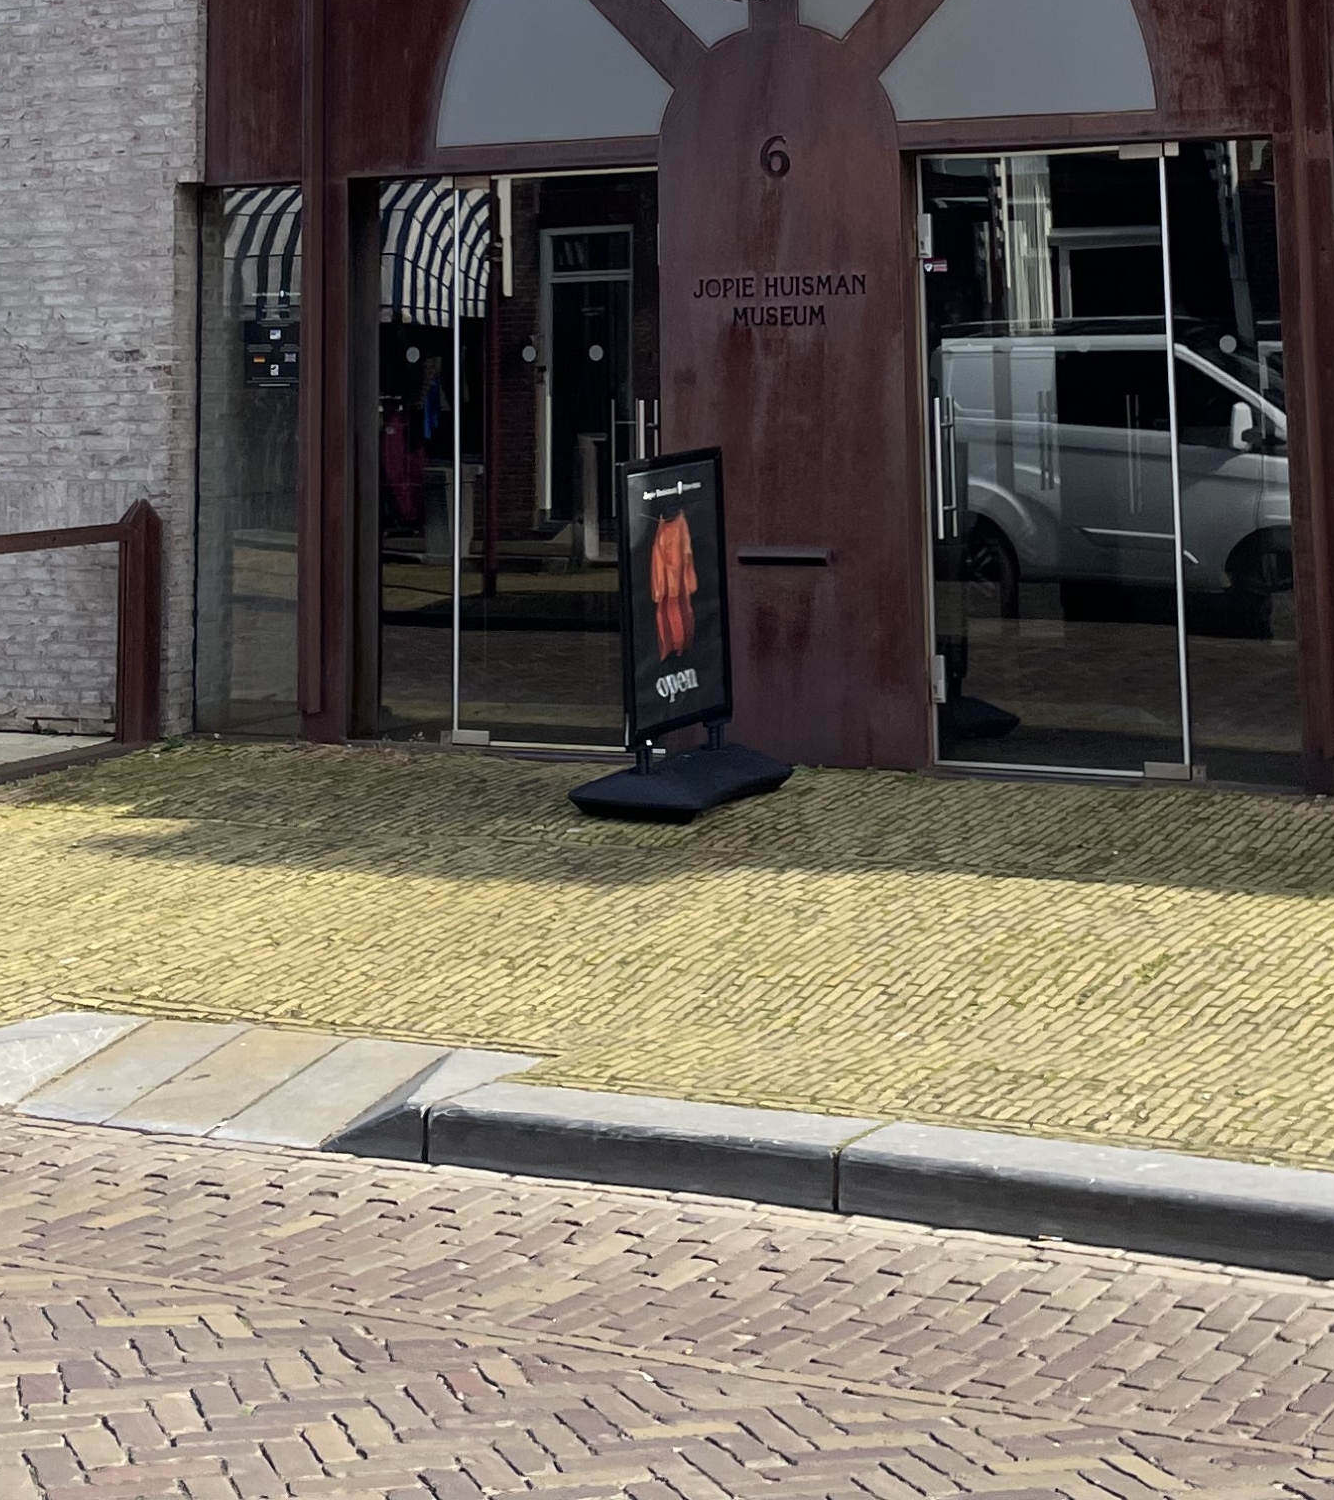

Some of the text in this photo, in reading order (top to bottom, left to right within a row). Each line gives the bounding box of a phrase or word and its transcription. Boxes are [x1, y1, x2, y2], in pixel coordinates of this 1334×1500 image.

[760, 135, 791, 178] 6
[693, 274, 867, 299] JOPIE HUISMAN
[733, 305, 826, 328] MUSEUM
[655, 668, 699, 703] open
